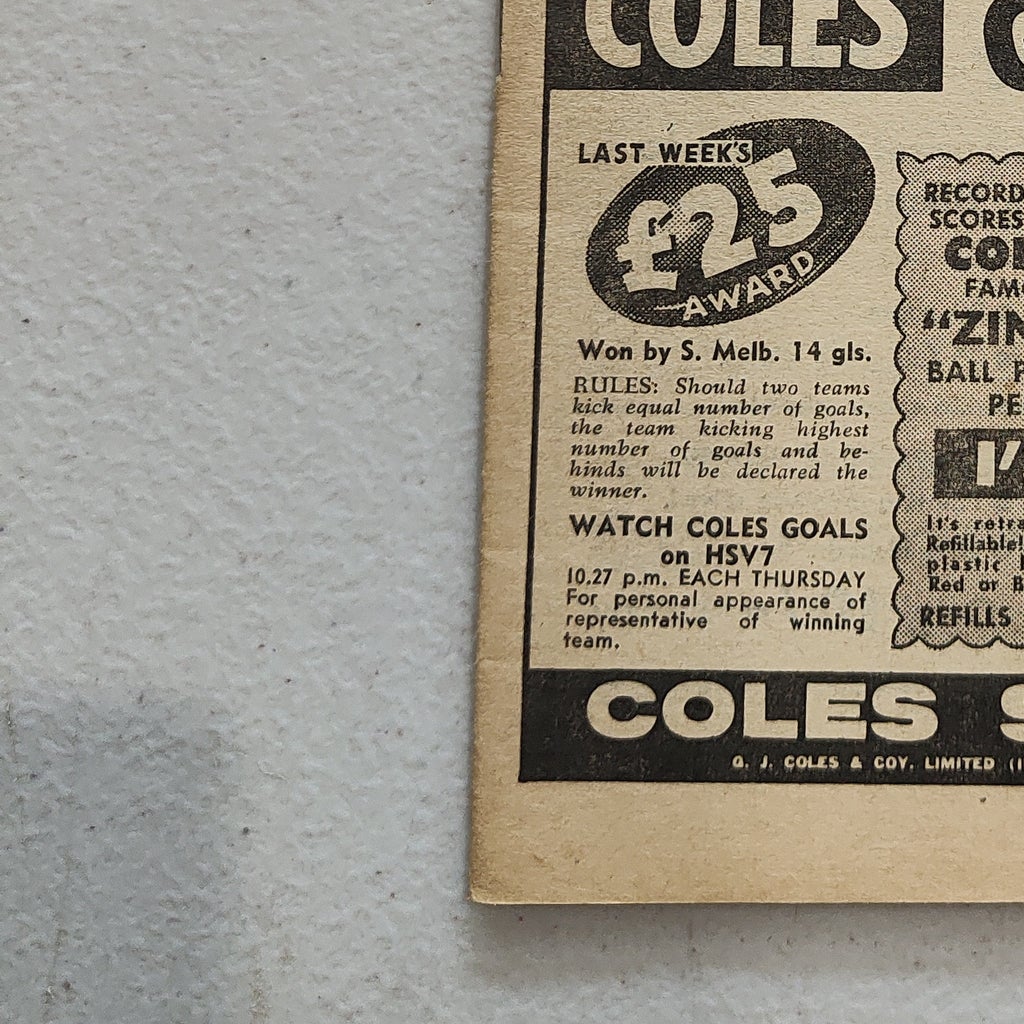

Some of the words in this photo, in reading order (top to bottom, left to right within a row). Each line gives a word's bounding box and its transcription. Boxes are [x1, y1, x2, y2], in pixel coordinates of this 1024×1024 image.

[579, 142, 645, 164] LAST
[659, 141, 752, 164] WEEK'S
[924, 183, 1024, 203] RECORD
[615, 149, 824, 293] £25
[929, 210, 1024, 230] SCORES
[682, 251, 816, 321] AWARD
[578, 339, 633, 361] Won
[644, 339, 671, 365] by
[681, 340, 701, 361] S.
[712, 340, 780, 362] Melb.
[793, 341, 821, 361] 14
[832, 342, 872, 365] gls.
[927, 360, 993, 384] BALL
[574, 377, 659, 394] RULES:
[675, 378, 746, 395] Should
[762, 381, 798, 395] two
[814, 382, 870, 395] teams
[572, 398, 614, 414] kick
[626, 399, 681, 417] equal
[694, 400, 771, 415] number
[784, 400, 802, 417] of
[814, 401, 869, 420] goals,
[571, 420, 603, 435] the
[627, 422, 675, 436] team
[699, 421, 774, 439] kicking
[797, 421, 869, 440] highest
[571, 441, 649, 456] number
[671, 441, 691, 459] of
[712, 442, 762, 461] goals
[781, 443, 818, 458] and
[840, 443, 868, 459] be-
[569, 462, 625, 477] hinds
[642, 463, 681, 478] will
[698, 463, 720, 479] be
[736, 464, 821, 480] declared
[837, 465, 868, 480] the
[570, 486, 647, 498] winner.
[570, 515, 673, 538] WATCH
[687, 517, 768, 538] COLES
[781, 519, 868, 539] GOALS
[927, 514, 959, 531] It's
[926, 534, 1023, 552] Refillable!
[661, 550, 689, 565] on
[705, 545, 775, 565] HSV7
[927, 554, 1001, 574] plastic
[567, 568, 612, 585] 10.27
[623, 572, 668, 588] p.m.
[679, 569, 740, 586] EACH
[752, 570, 866, 589] THURSDAY
[929, 576, 965, 592] Red
[979, 579, 999, 591] or
[566, 589, 598, 605] For
[614, 590, 698, 609] personal
[714, 596, 831, 610] appearance
[846, 593, 867, 609] of
[565, 611, 708, 630] representative
[740, 613, 760, 628] of
[790, 614, 865, 634] winning
[920, 605, 1011, 626] REFILLS
[564, 632, 620, 649] team.
[586, 681, 940, 742] COLES
[760, 755, 773, 768] J.
[784, 755, 839, 769] COLES
[850, 755, 862, 768] &
[874, 756, 914, 769] COY.
[924, 756, 995, 770] LIMITED
